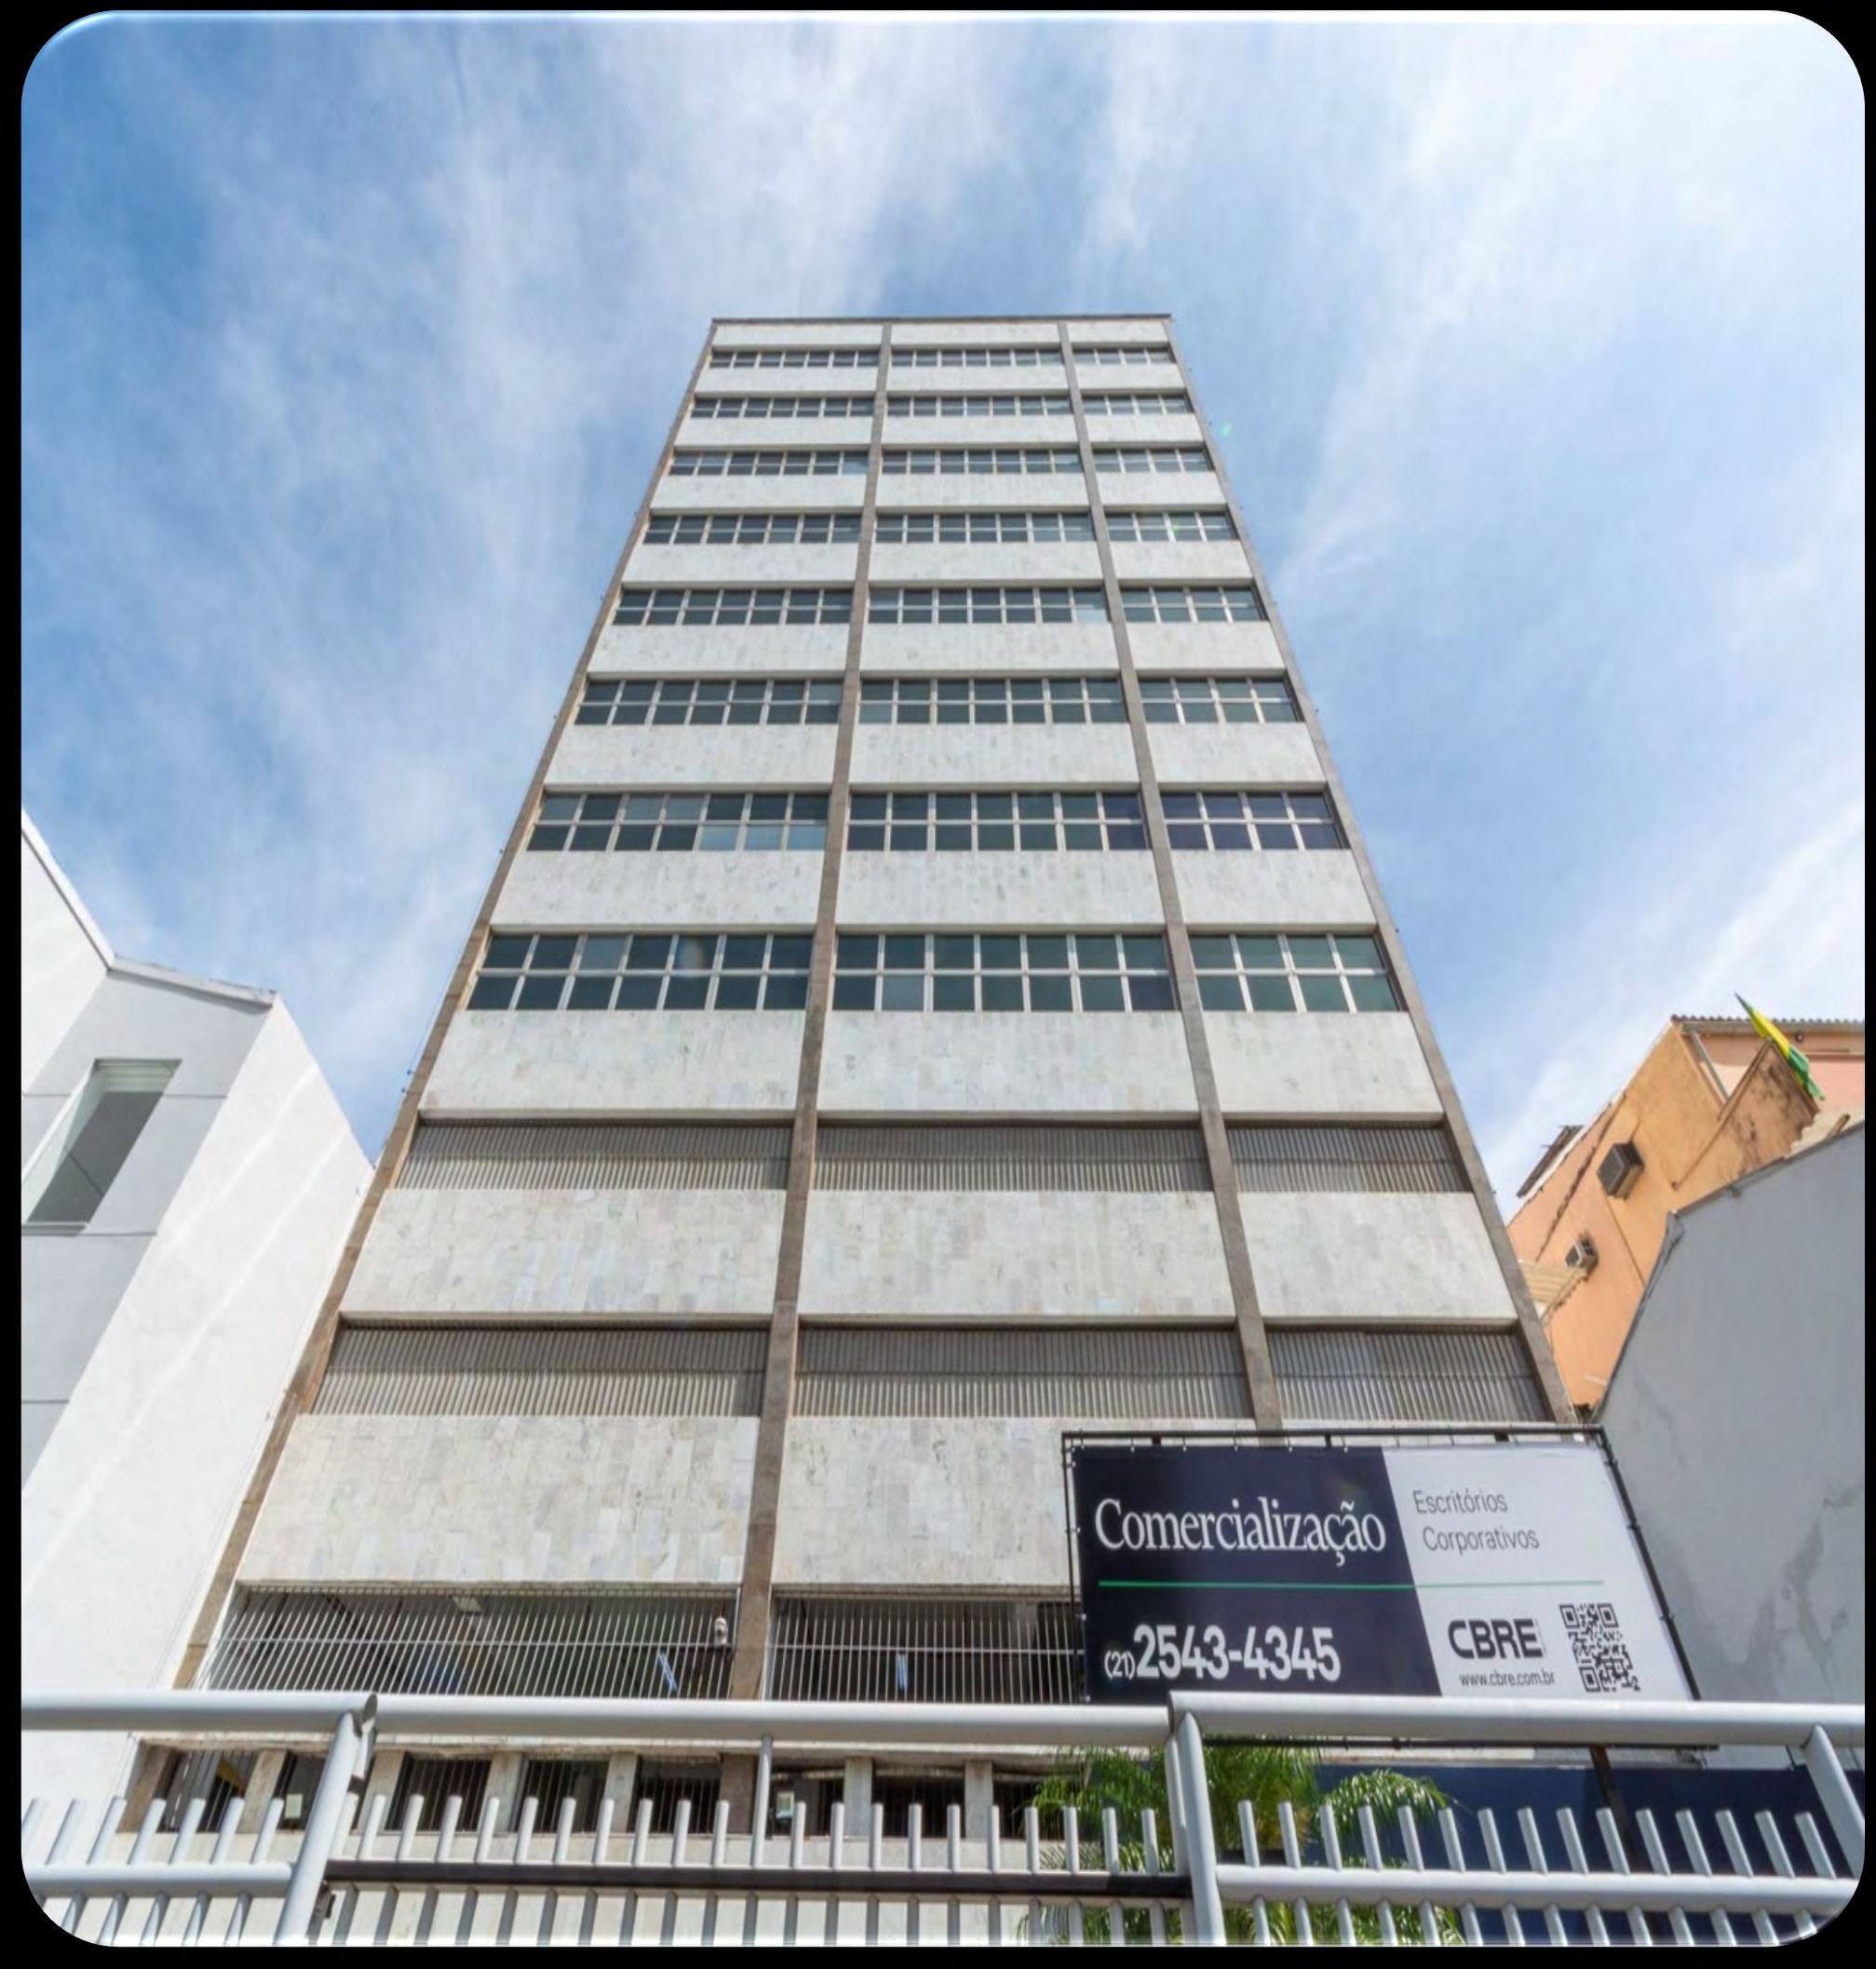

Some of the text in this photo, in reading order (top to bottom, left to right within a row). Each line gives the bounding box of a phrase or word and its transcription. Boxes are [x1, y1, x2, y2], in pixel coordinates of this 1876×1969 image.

[1412, 1490, 1509, 1516] Escritórios
[1095, 1497, 1387, 1566] Comercialização
[1422, 1526, 1541, 1556] Corporativos
[1133, 1624, 1342, 1681] 2543-4345
[1448, 1618, 1545, 1659] CBRE
[1458, 1668, 1556, 1687] www.cbre.com.br
